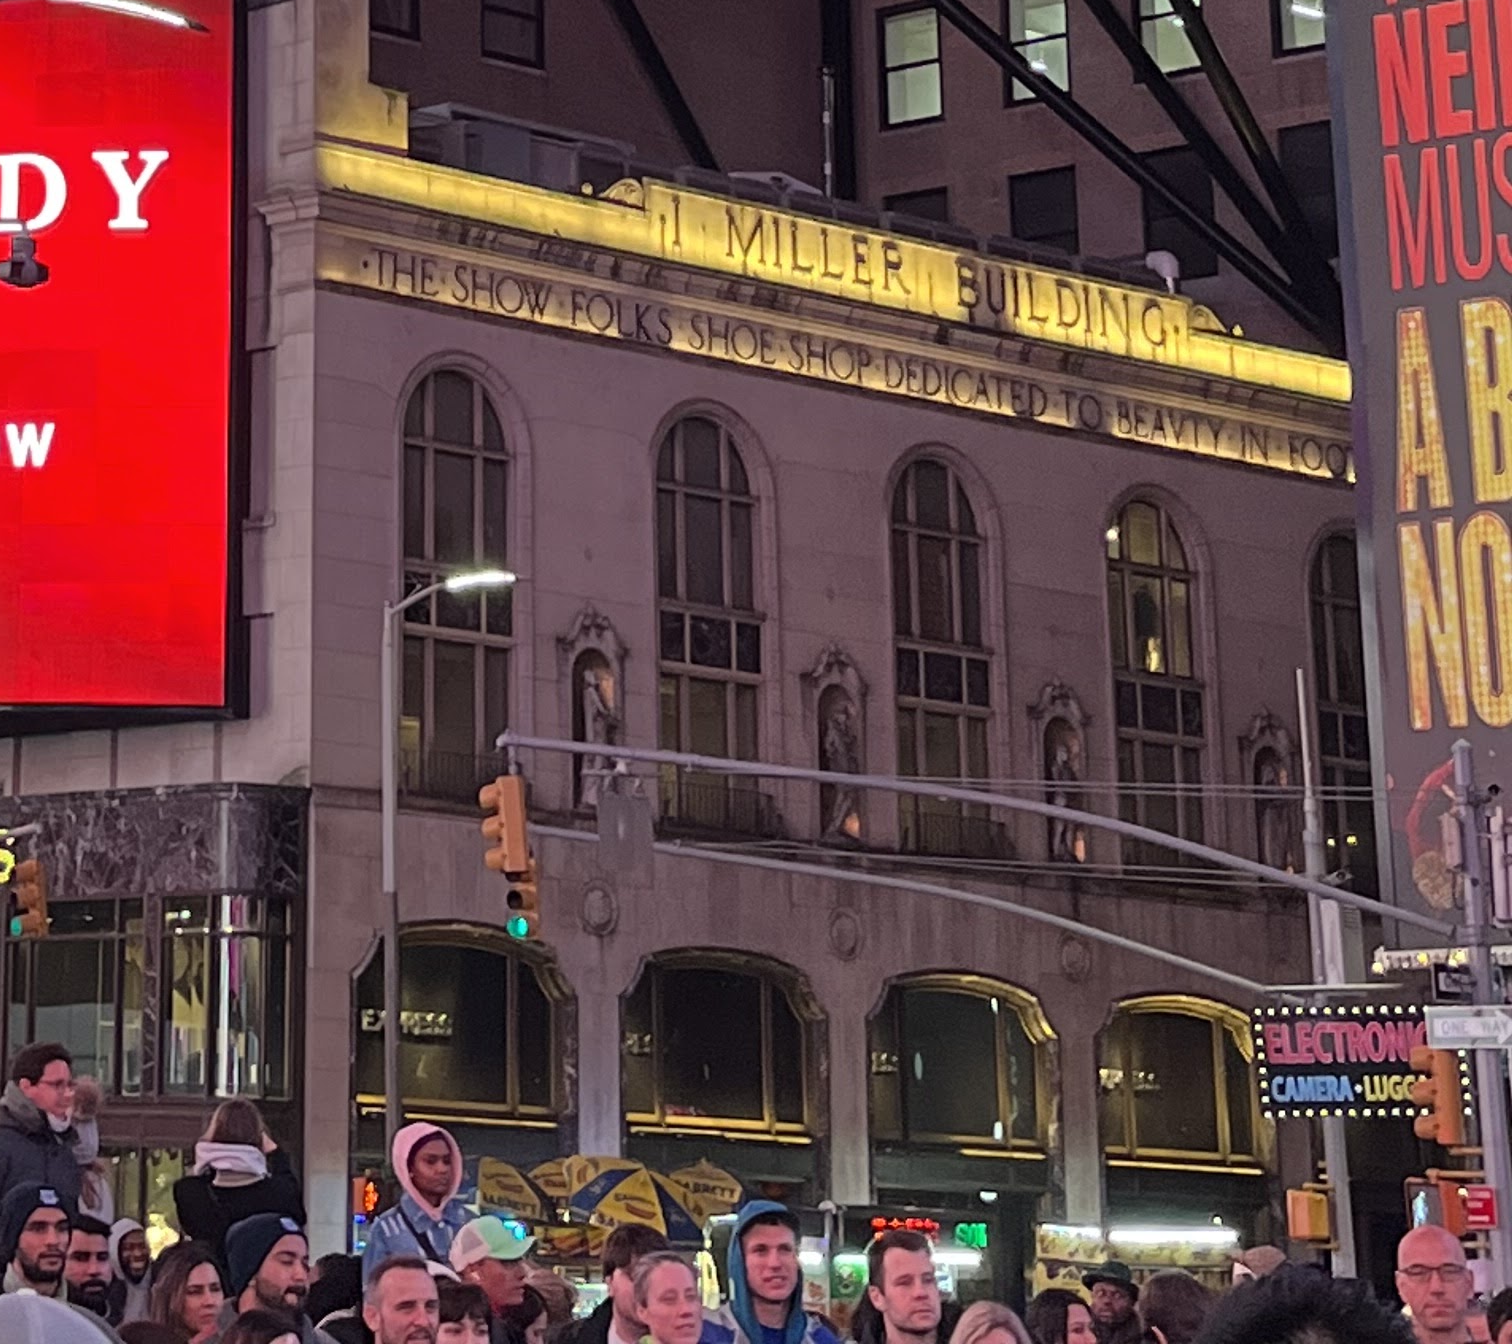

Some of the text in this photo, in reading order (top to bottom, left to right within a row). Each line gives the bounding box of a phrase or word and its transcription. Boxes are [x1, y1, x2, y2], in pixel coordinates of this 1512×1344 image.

[725, 204, 912, 296] MILLER
[954, 255, 1167, 348] BUILDING
[371, 248, 440, 297] THE
[451, 263, 553, 320] SHOW
[570, 288, 674, 346] FOLKS
[688, 313, 776, 365] SHOE
[787, 333, 871, 384] SHOP
[883, 353, 1048, 418] DEDICATED
[1059, 388, 1103, 430] TO
[1238, 423, 1270, 462] IN
[1396, 305, 1455, 514] A
[1264, 1020, 1426, 1066] ELECTRONI
[1270, 1074, 1355, 1103] CAMERA
